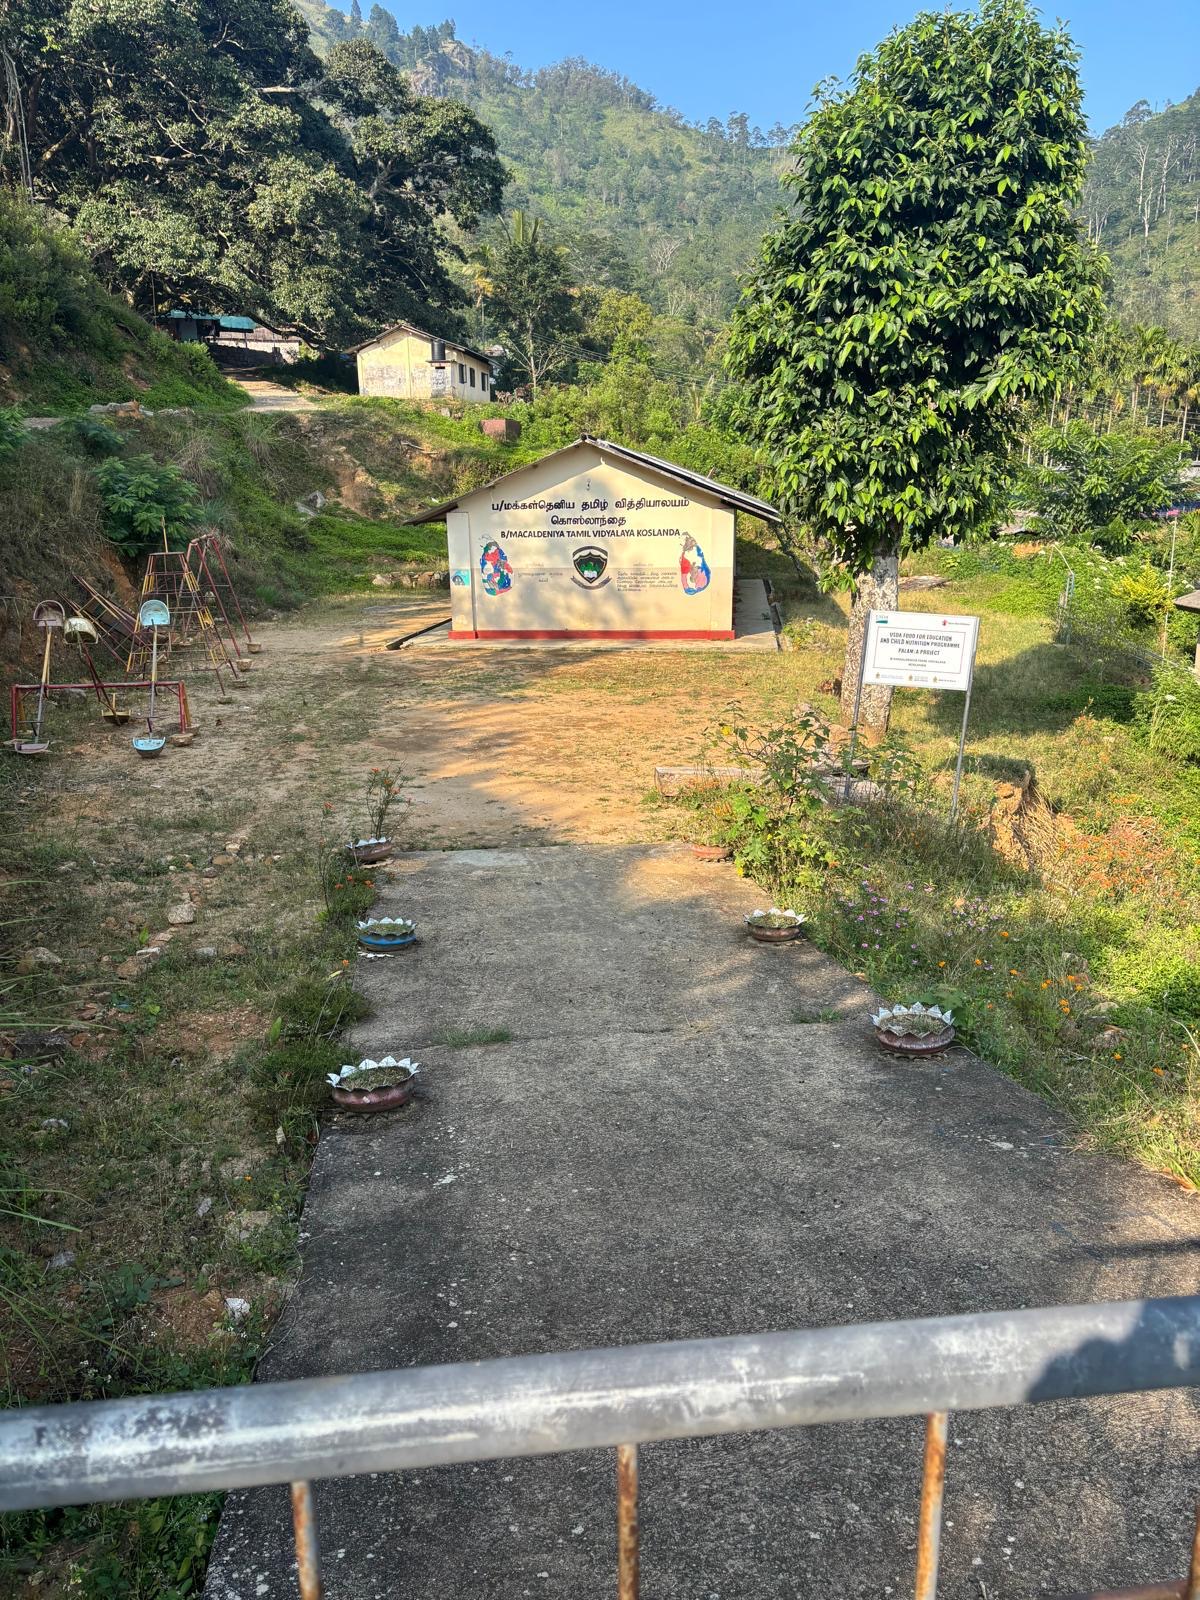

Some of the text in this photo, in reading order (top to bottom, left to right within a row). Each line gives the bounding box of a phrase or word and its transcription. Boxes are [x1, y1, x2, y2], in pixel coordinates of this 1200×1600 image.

[581, 499, 608, 511] தமிழ்
[615, 497, 690, 510] வித்தியாலயம்
[500, 528, 681, 539] B/MACALDENIYA TAMIL VIDYALAYA KOSLANDA
[926, 634, 953, 642] EDUCATION
[930, 641, 960, 649] PROGRAMME
